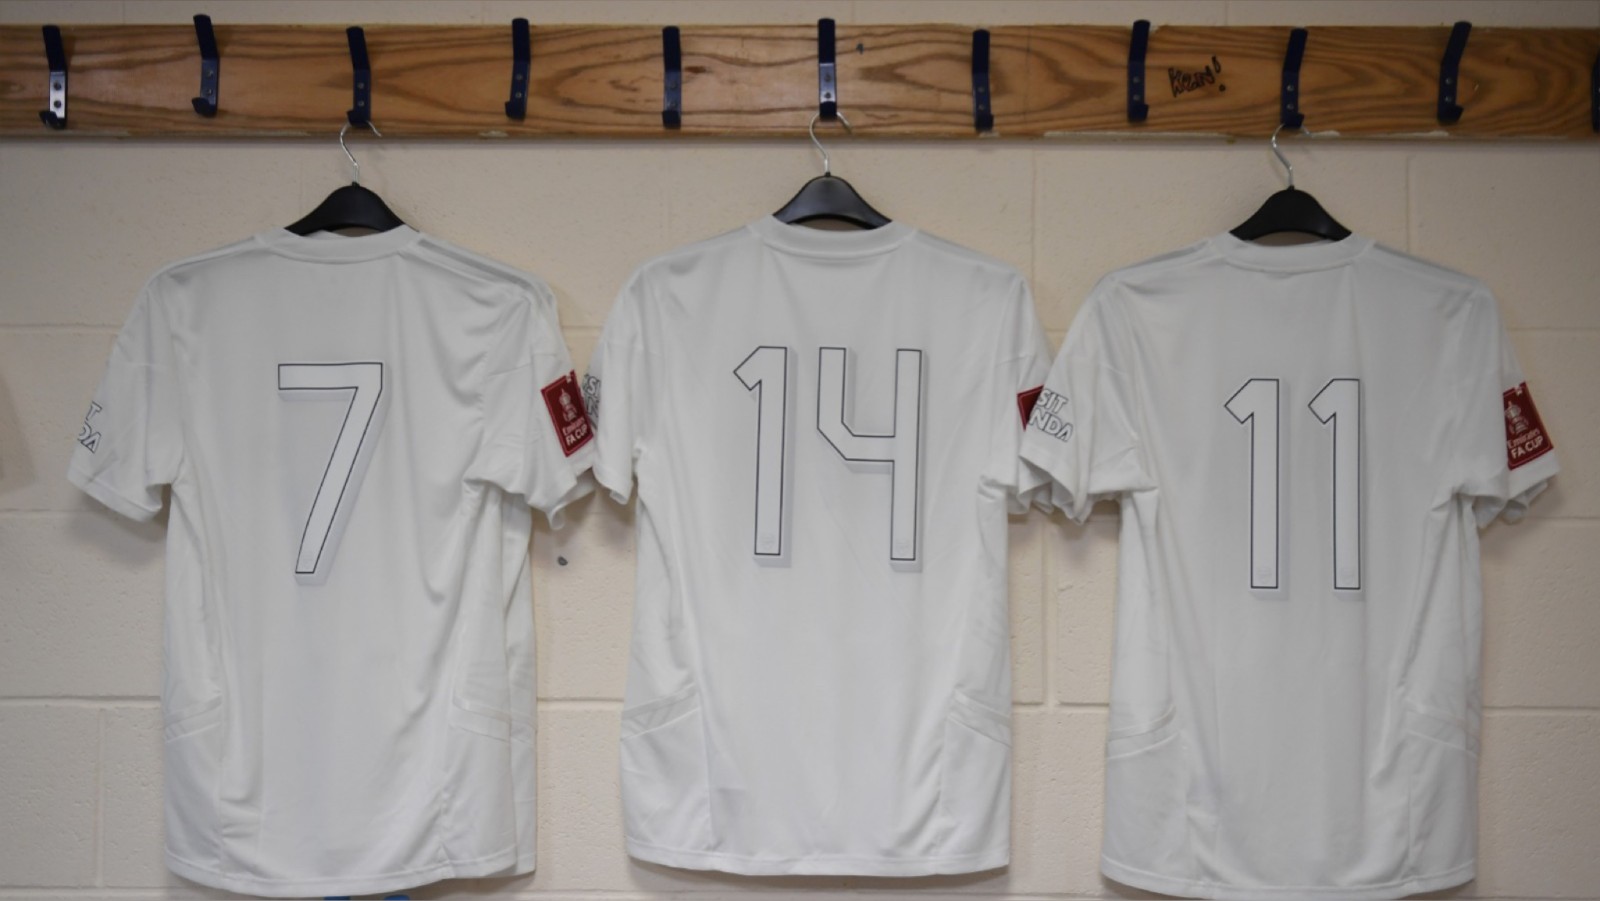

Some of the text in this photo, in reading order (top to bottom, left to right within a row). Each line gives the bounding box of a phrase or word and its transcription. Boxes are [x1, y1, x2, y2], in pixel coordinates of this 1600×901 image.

[277, 361, 385, 575] 7
[565, 423, 588, 446] FA CUP
[732, 345, 923, 562] 14
[1223, 377, 1362, 590] 11
[1510, 435, 1544, 459] FA CUP
